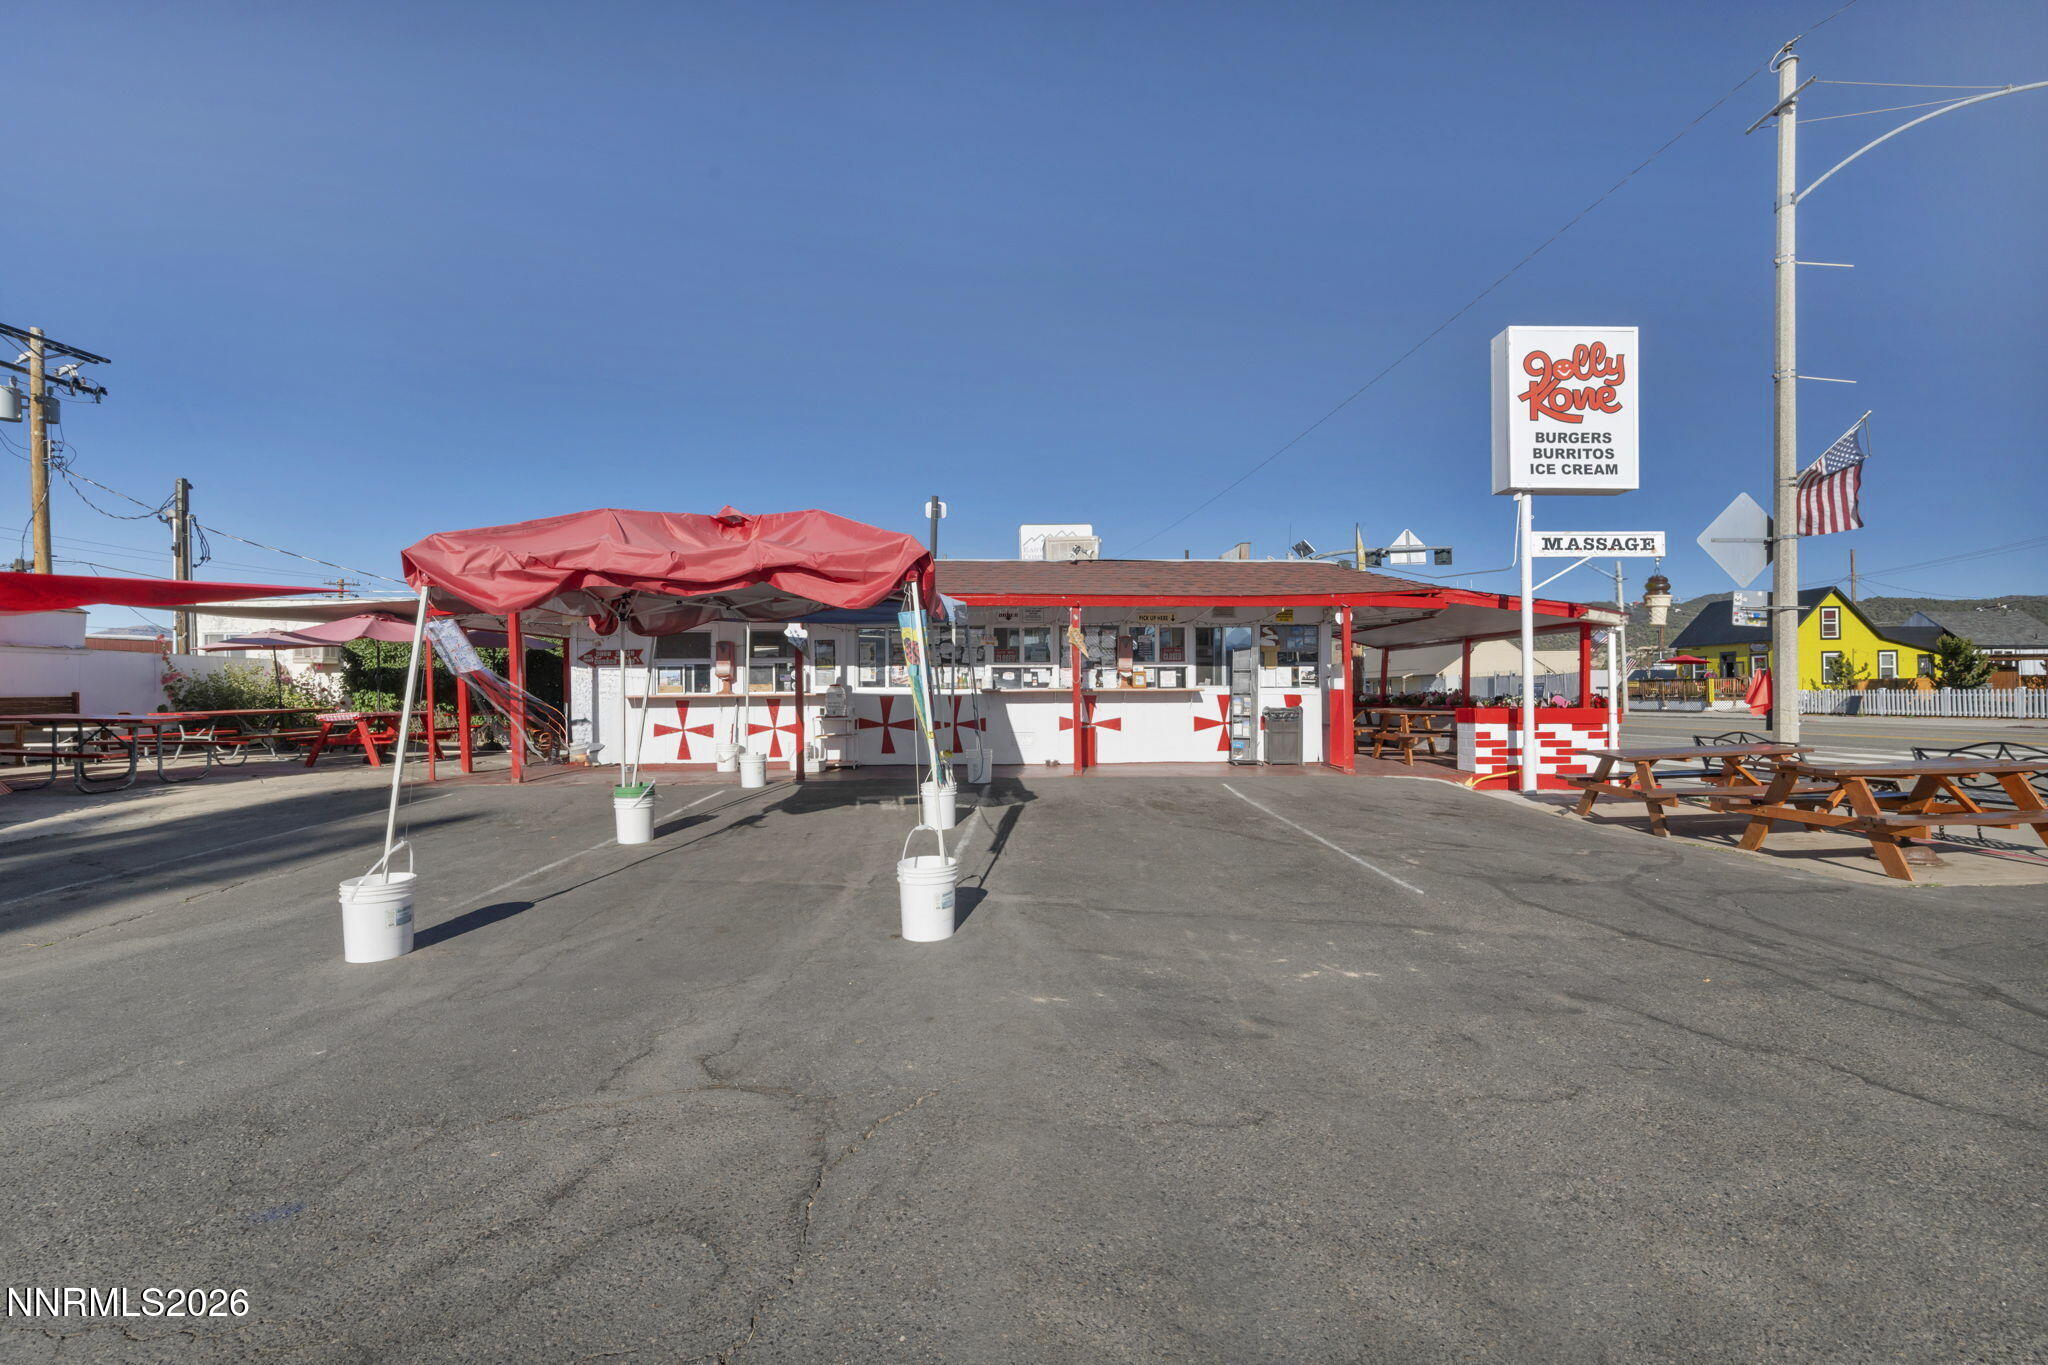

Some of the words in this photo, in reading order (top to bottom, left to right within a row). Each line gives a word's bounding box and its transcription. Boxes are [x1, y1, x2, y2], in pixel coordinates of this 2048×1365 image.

[1523, 341, 1625, 387] Jolly
[1517, 379, 1623, 424] Kone
[1535, 432, 1612, 444] BURGERS
[1532, 448, 1615, 460] BURRITOS
[1530, 463, 1556, 475] ICE
[1561, 463, 1618, 475] CREAM
[1541, 537, 1655, 551] MASSAGE
